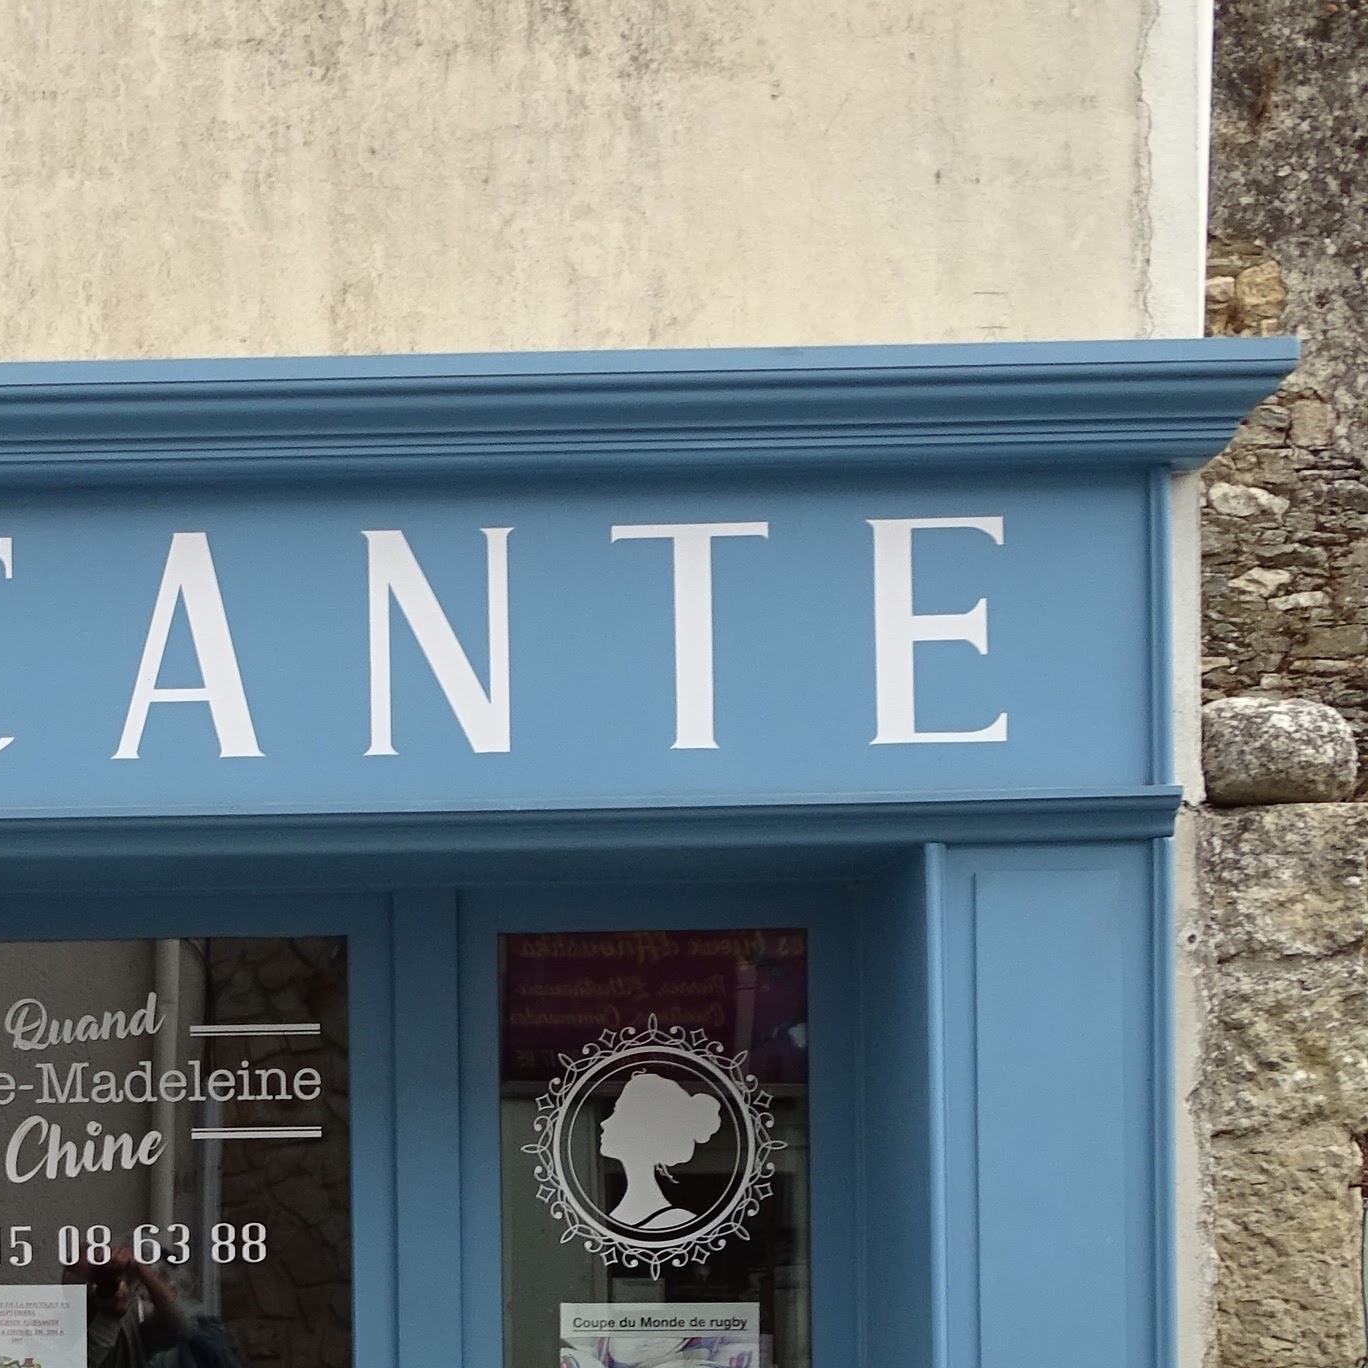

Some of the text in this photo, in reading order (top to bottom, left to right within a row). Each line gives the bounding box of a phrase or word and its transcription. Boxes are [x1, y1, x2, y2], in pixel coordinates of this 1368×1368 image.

[5, 992, 166, 1051] Quand
[5, 1115, 166, 1184] Chine
[58, 1225, 112, 1266] 08
[133, 1224, 190, 1265] 63
[211, 1223, 268, 1264] 88
[573, 1316, 748, 1330] Coupe du Monde de rugby
